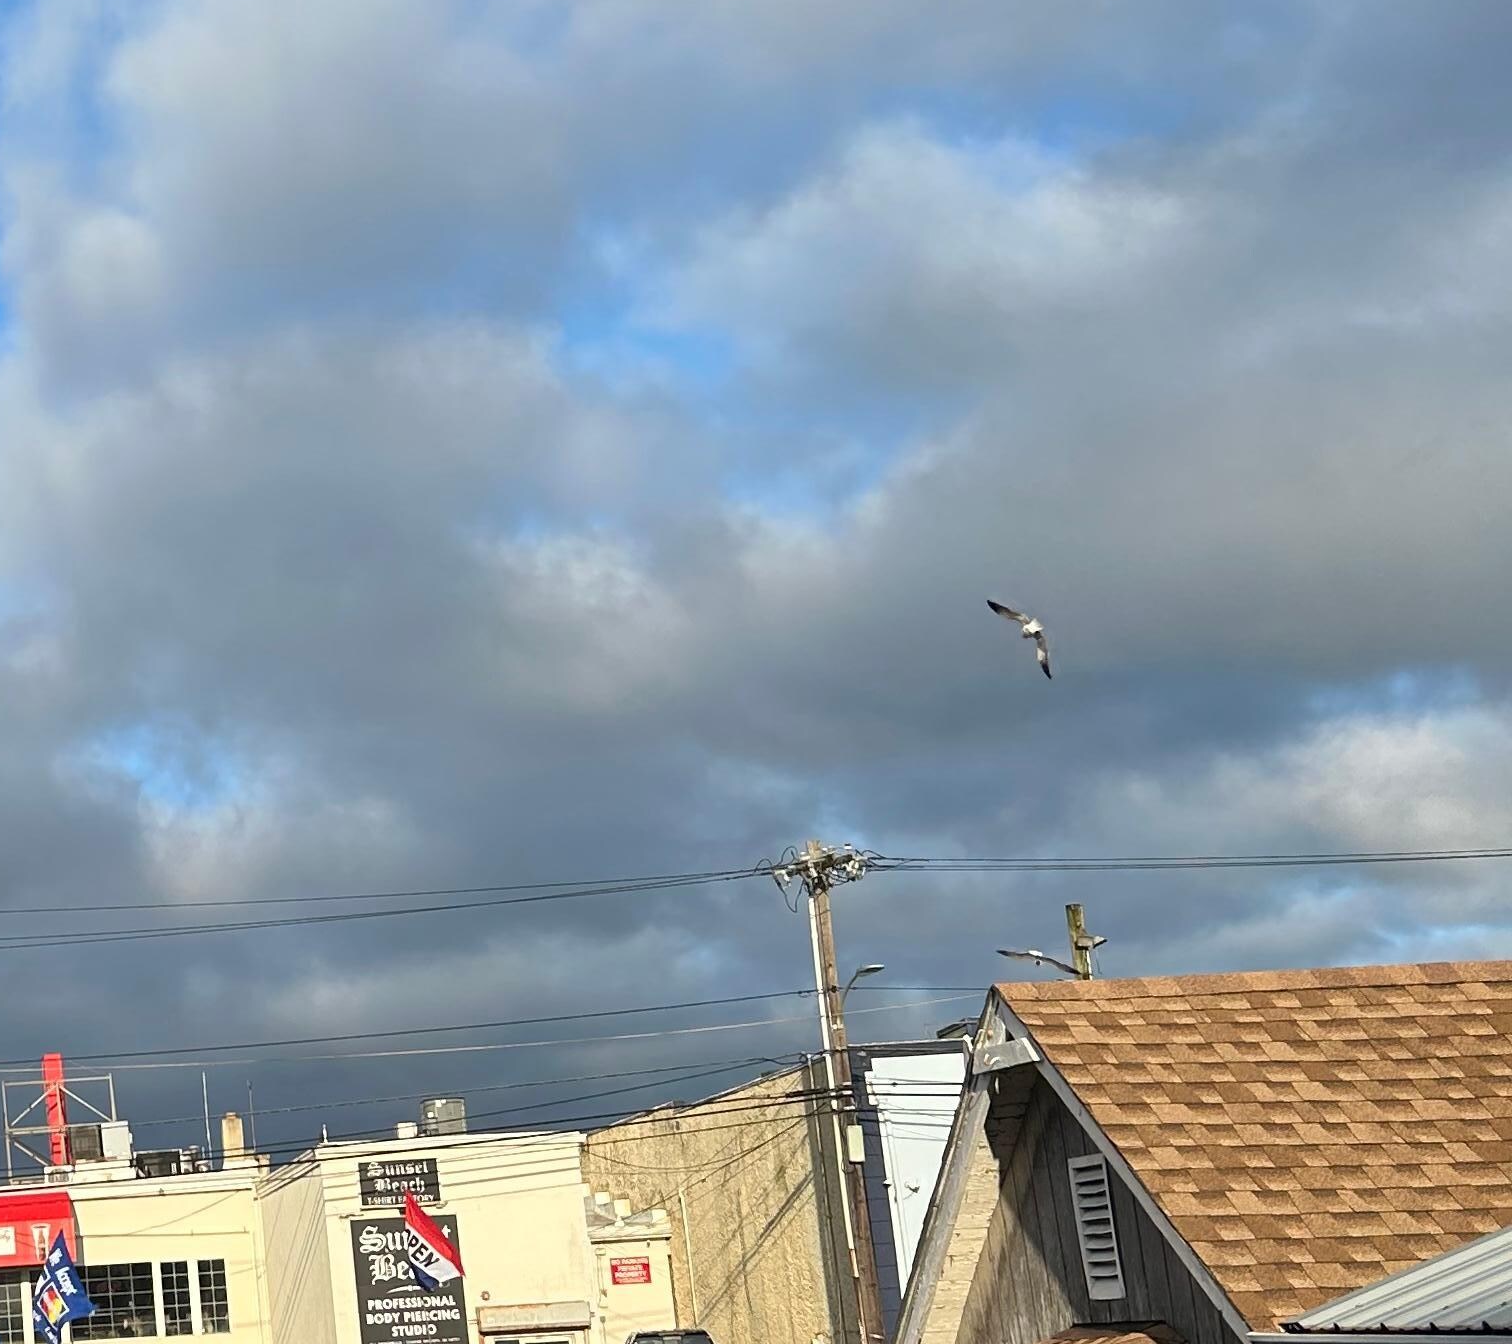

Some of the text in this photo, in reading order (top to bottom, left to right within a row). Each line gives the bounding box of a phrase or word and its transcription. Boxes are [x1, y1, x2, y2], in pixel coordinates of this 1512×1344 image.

[367, 1161, 429, 1177] Sunset
[373, 1177, 426, 1193] Beach
[397, 1194, 435, 1204] FATORY
[367, 1295, 457, 1311] PROFESSIONAL
[365, 1308, 461, 1325] BODY PIERCING
[391, 1323, 438, 1338] STUDIO
